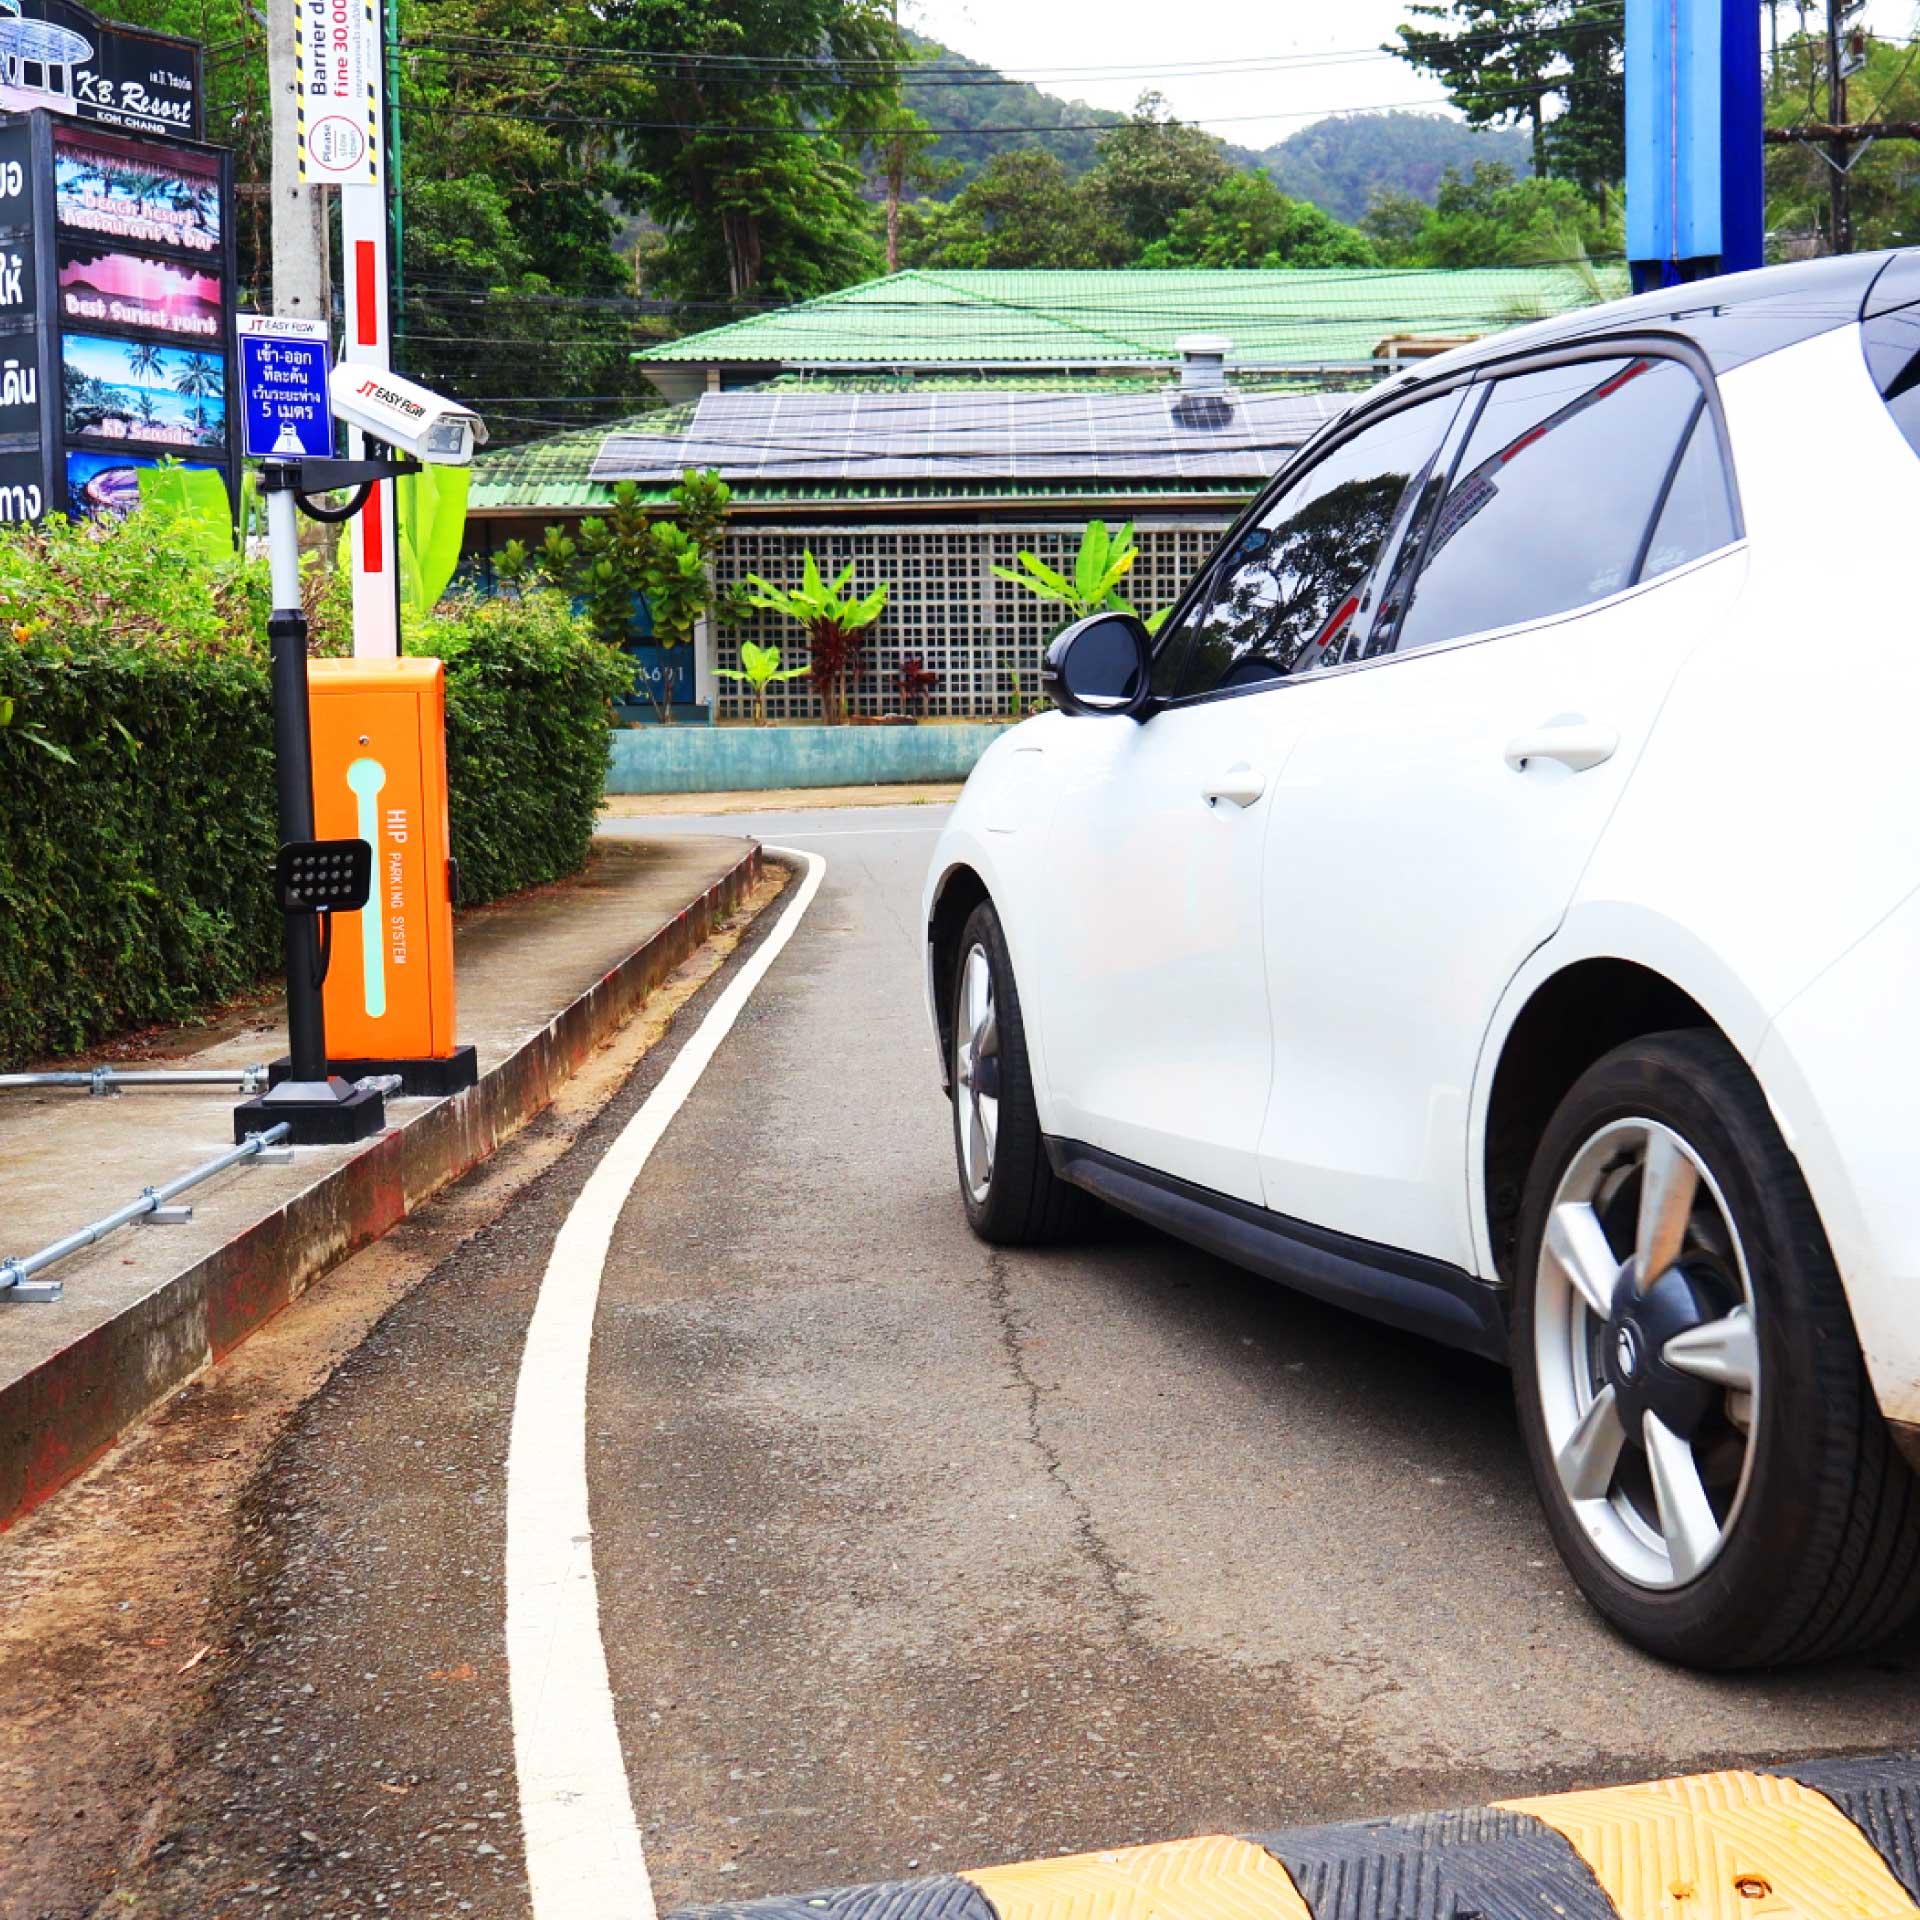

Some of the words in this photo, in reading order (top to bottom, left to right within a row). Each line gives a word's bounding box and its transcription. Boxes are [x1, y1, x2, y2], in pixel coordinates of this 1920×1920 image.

[309, 20, 327, 96] Barrier
[333, 57, 349, 97] fine
[120, 80, 191, 122] Resort
[97, 110, 121, 125] KOH
[124, 116, 166, 134] CHANG
[322, 124, 332, 162] Please
[65, 293, 107, 319] Best
[109, 300, 168, 330] Sunset
[249, 319, 264, 332] JT
[265, 319, 289, 331] EASY
[256, 341, 312, 365] เข้า-ออก
[262, 401, 271, 418] 5
[277, 403, 314, 420] เมตร
[356, 380, 379, 397] JT
[375, 387, 402, 406] EASY
[387, 809, 408, 844] HIP
[389, 853, 404, 908] PARKING
[391, 916, 407, 964] SYSTEM
